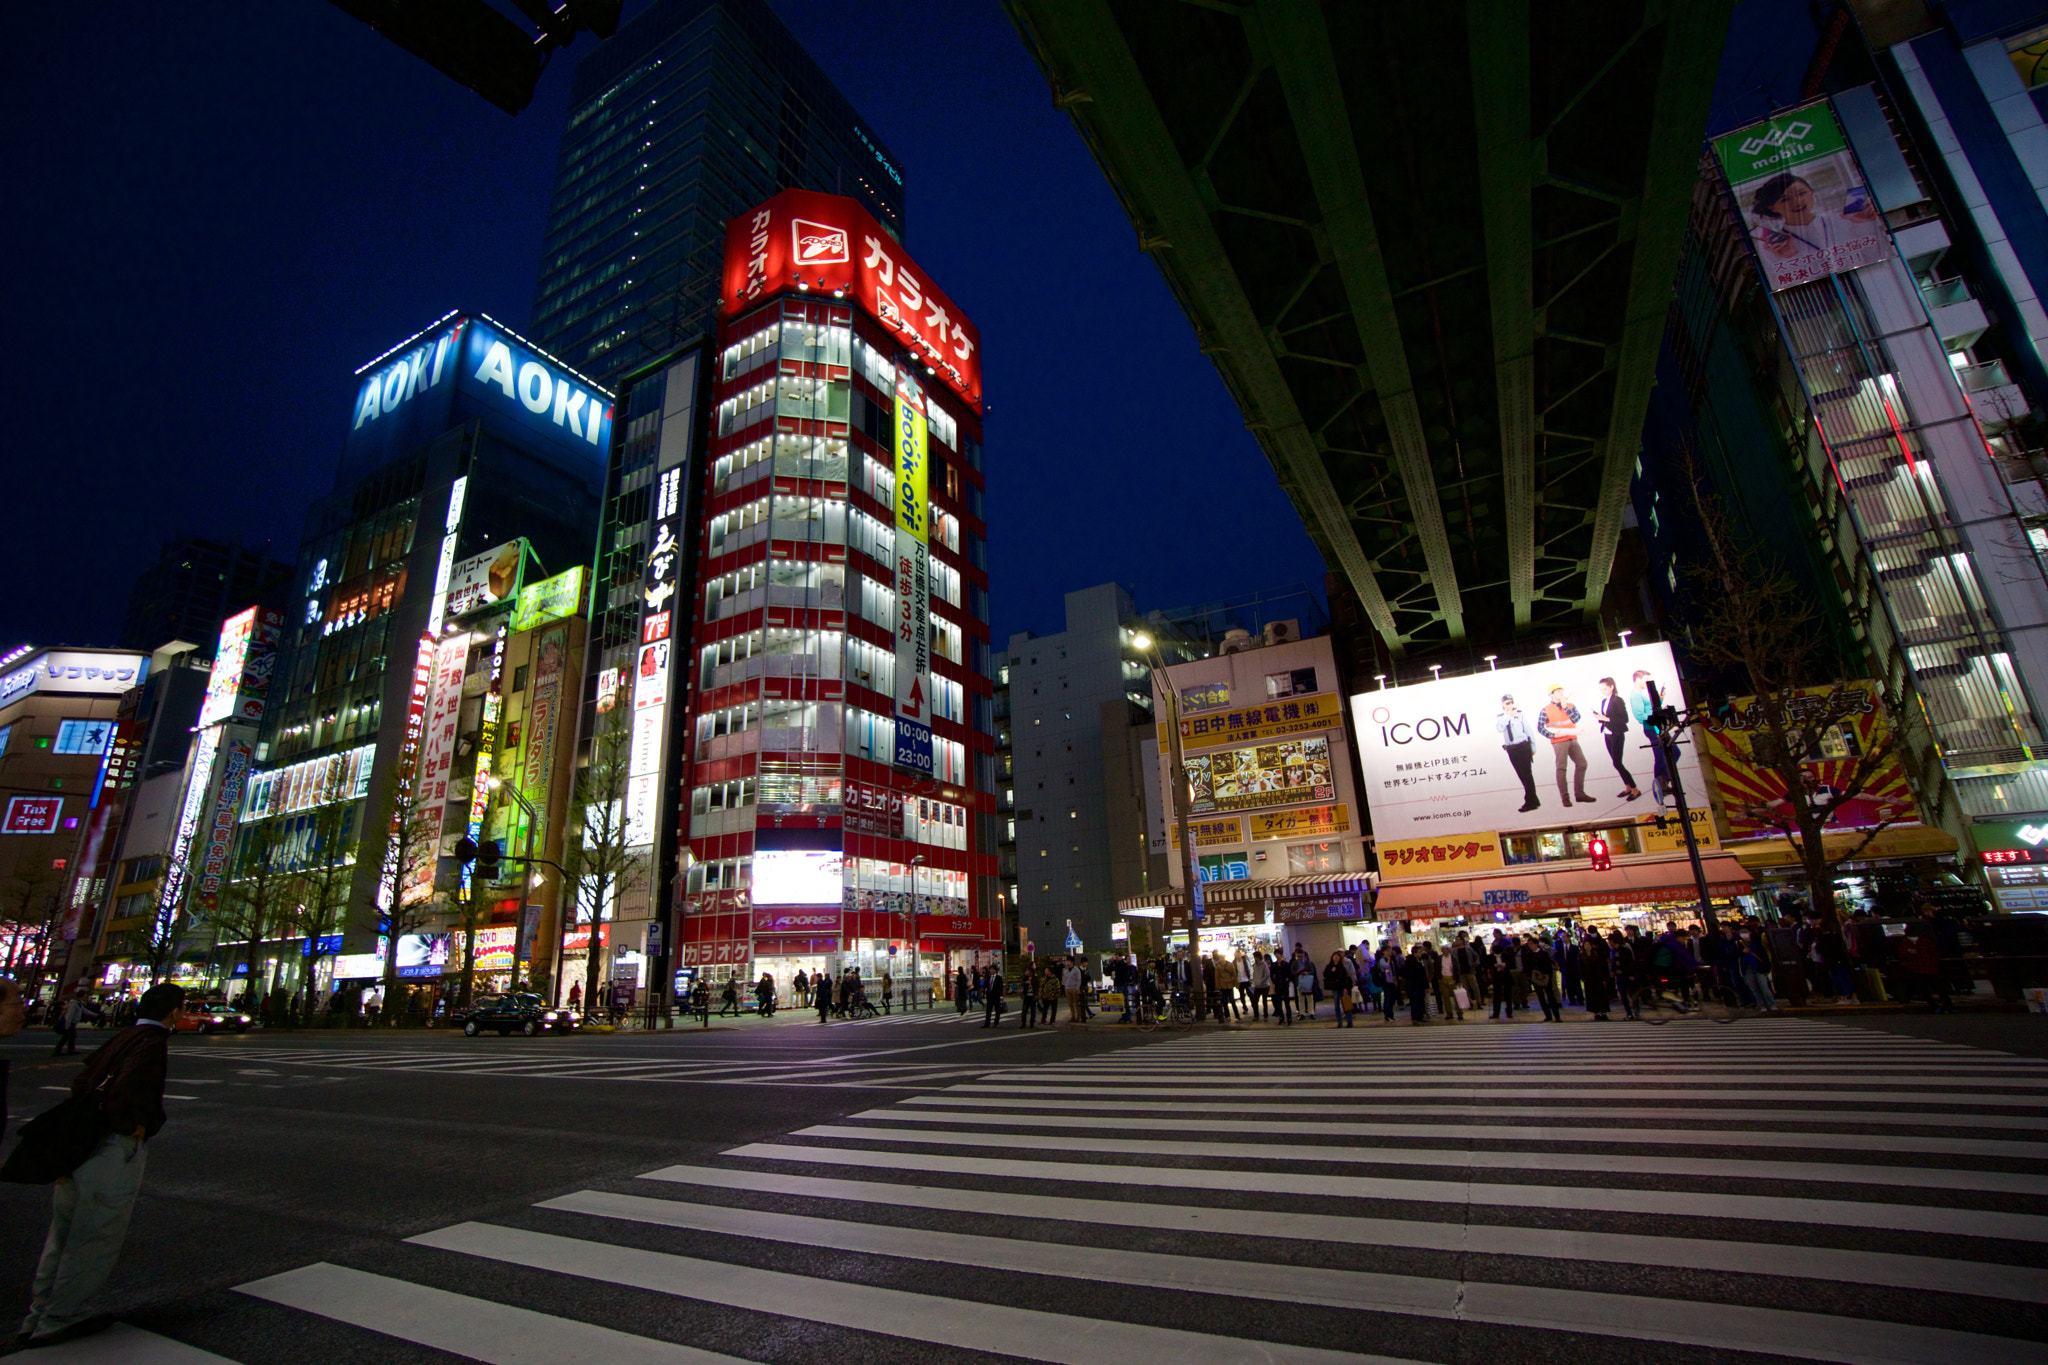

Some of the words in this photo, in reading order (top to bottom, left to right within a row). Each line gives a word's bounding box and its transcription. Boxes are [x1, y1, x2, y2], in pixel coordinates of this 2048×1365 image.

[1752, 143, 1815, 170] mobile
[746, 208, 771, 300] カラオケ
[1774, 237, 1878, 273] スマホのお悩み
[864, 234, 975, 361] カラオケ
[354, 334, 449, 431] AOKI
[474, 340, 603, 446] AOKI
[898, 369, 924, 410] 本
[458, 557, 493, 576] ハニトー
[898, 555, 913, 643] 徒歩3分
[914, 541, 927, 676] 万世橋交差点左折
[48, 665, 135, 681] ソフマップ
[420, 645, 453, 802] カラオケパセラ
[434, 645, 466, 800] 曲数世界最強
[898, 720, 930, 744] 10:00
[1276, 719, 1332, 734] 03-3253-4001
[527, 703, 547, 787] ラムタラ
[638, 715, 654, 773] Anime
[898, 748, 931, 770] 23:00
[1396, 754, 1469, 773] 無線機とIP技術で
[1383, 768, 1487, 789] 世界をリードするアイコム
[22, 804, 49, 815] Tax
[634, 777, 651, 832] Plaza
[845, 784, 902, 813] カラオケ
[15, 815, 46, 827] Free
[846, 815, 858, 826] 3F
[1265, 812, 1335, 831] タイガー無線
[1413, 809, 1472, 823] www.icom.co.jp
[1384, 841, 1495, 866] ラジオセンター
[1484, 889, 1530, 905] FIGURE
[776, 915, 838, 926] ADORES
[1279, 904, 1355, 921] タイガー無線
[649, 925, 660, 938] P
[951, 921, 973, 930] カラオケ
[685, 943, 748, 964] カラオケ
